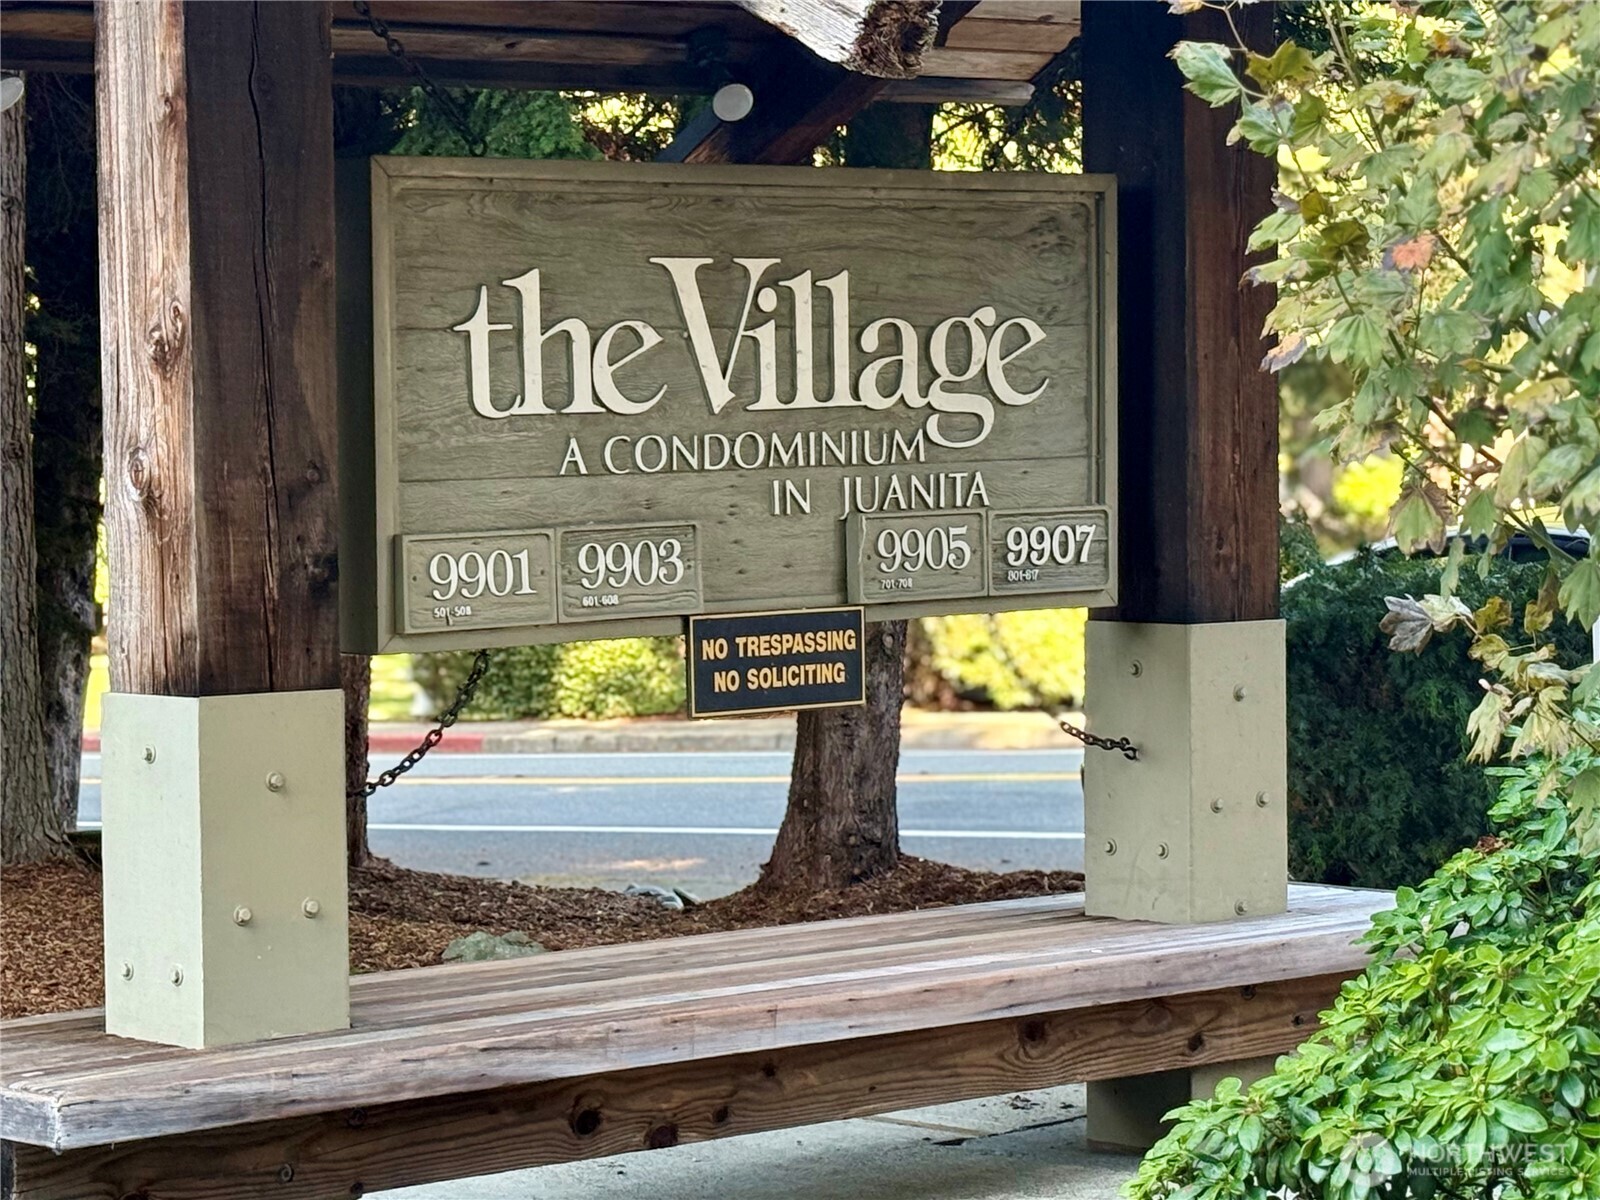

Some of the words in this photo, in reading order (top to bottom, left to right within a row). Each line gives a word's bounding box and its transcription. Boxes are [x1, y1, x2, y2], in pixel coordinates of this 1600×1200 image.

[453, 267, 668, 419] the
[649, 256, 1050, 449] Village
[559, 437, 588, 475] A
[604, 428, 926, 475] CONDOMINIUM
[772, 478, 811, 515] IN
[839, 470, 990, 521] JUANITA
[577, 538, 685, 589] 9903
[876, 524, 972, 574] 9905
[1006, 523, 1097, 568] 9907
[429, 548, 537, 601] 9901
[880, 577, 913, 590] 701-708
[1007, 569, 1039, 582] 801-817
[433, 605, 472, 618] 501-508
[582, 594, 619, 607] 601-608
[702, 637, 729, 661] NO
[735, 628, 857, 658] TRESPASSING
[714, 670, 740, 693] NO
[746, 662, 846, 690] SOLICITING
